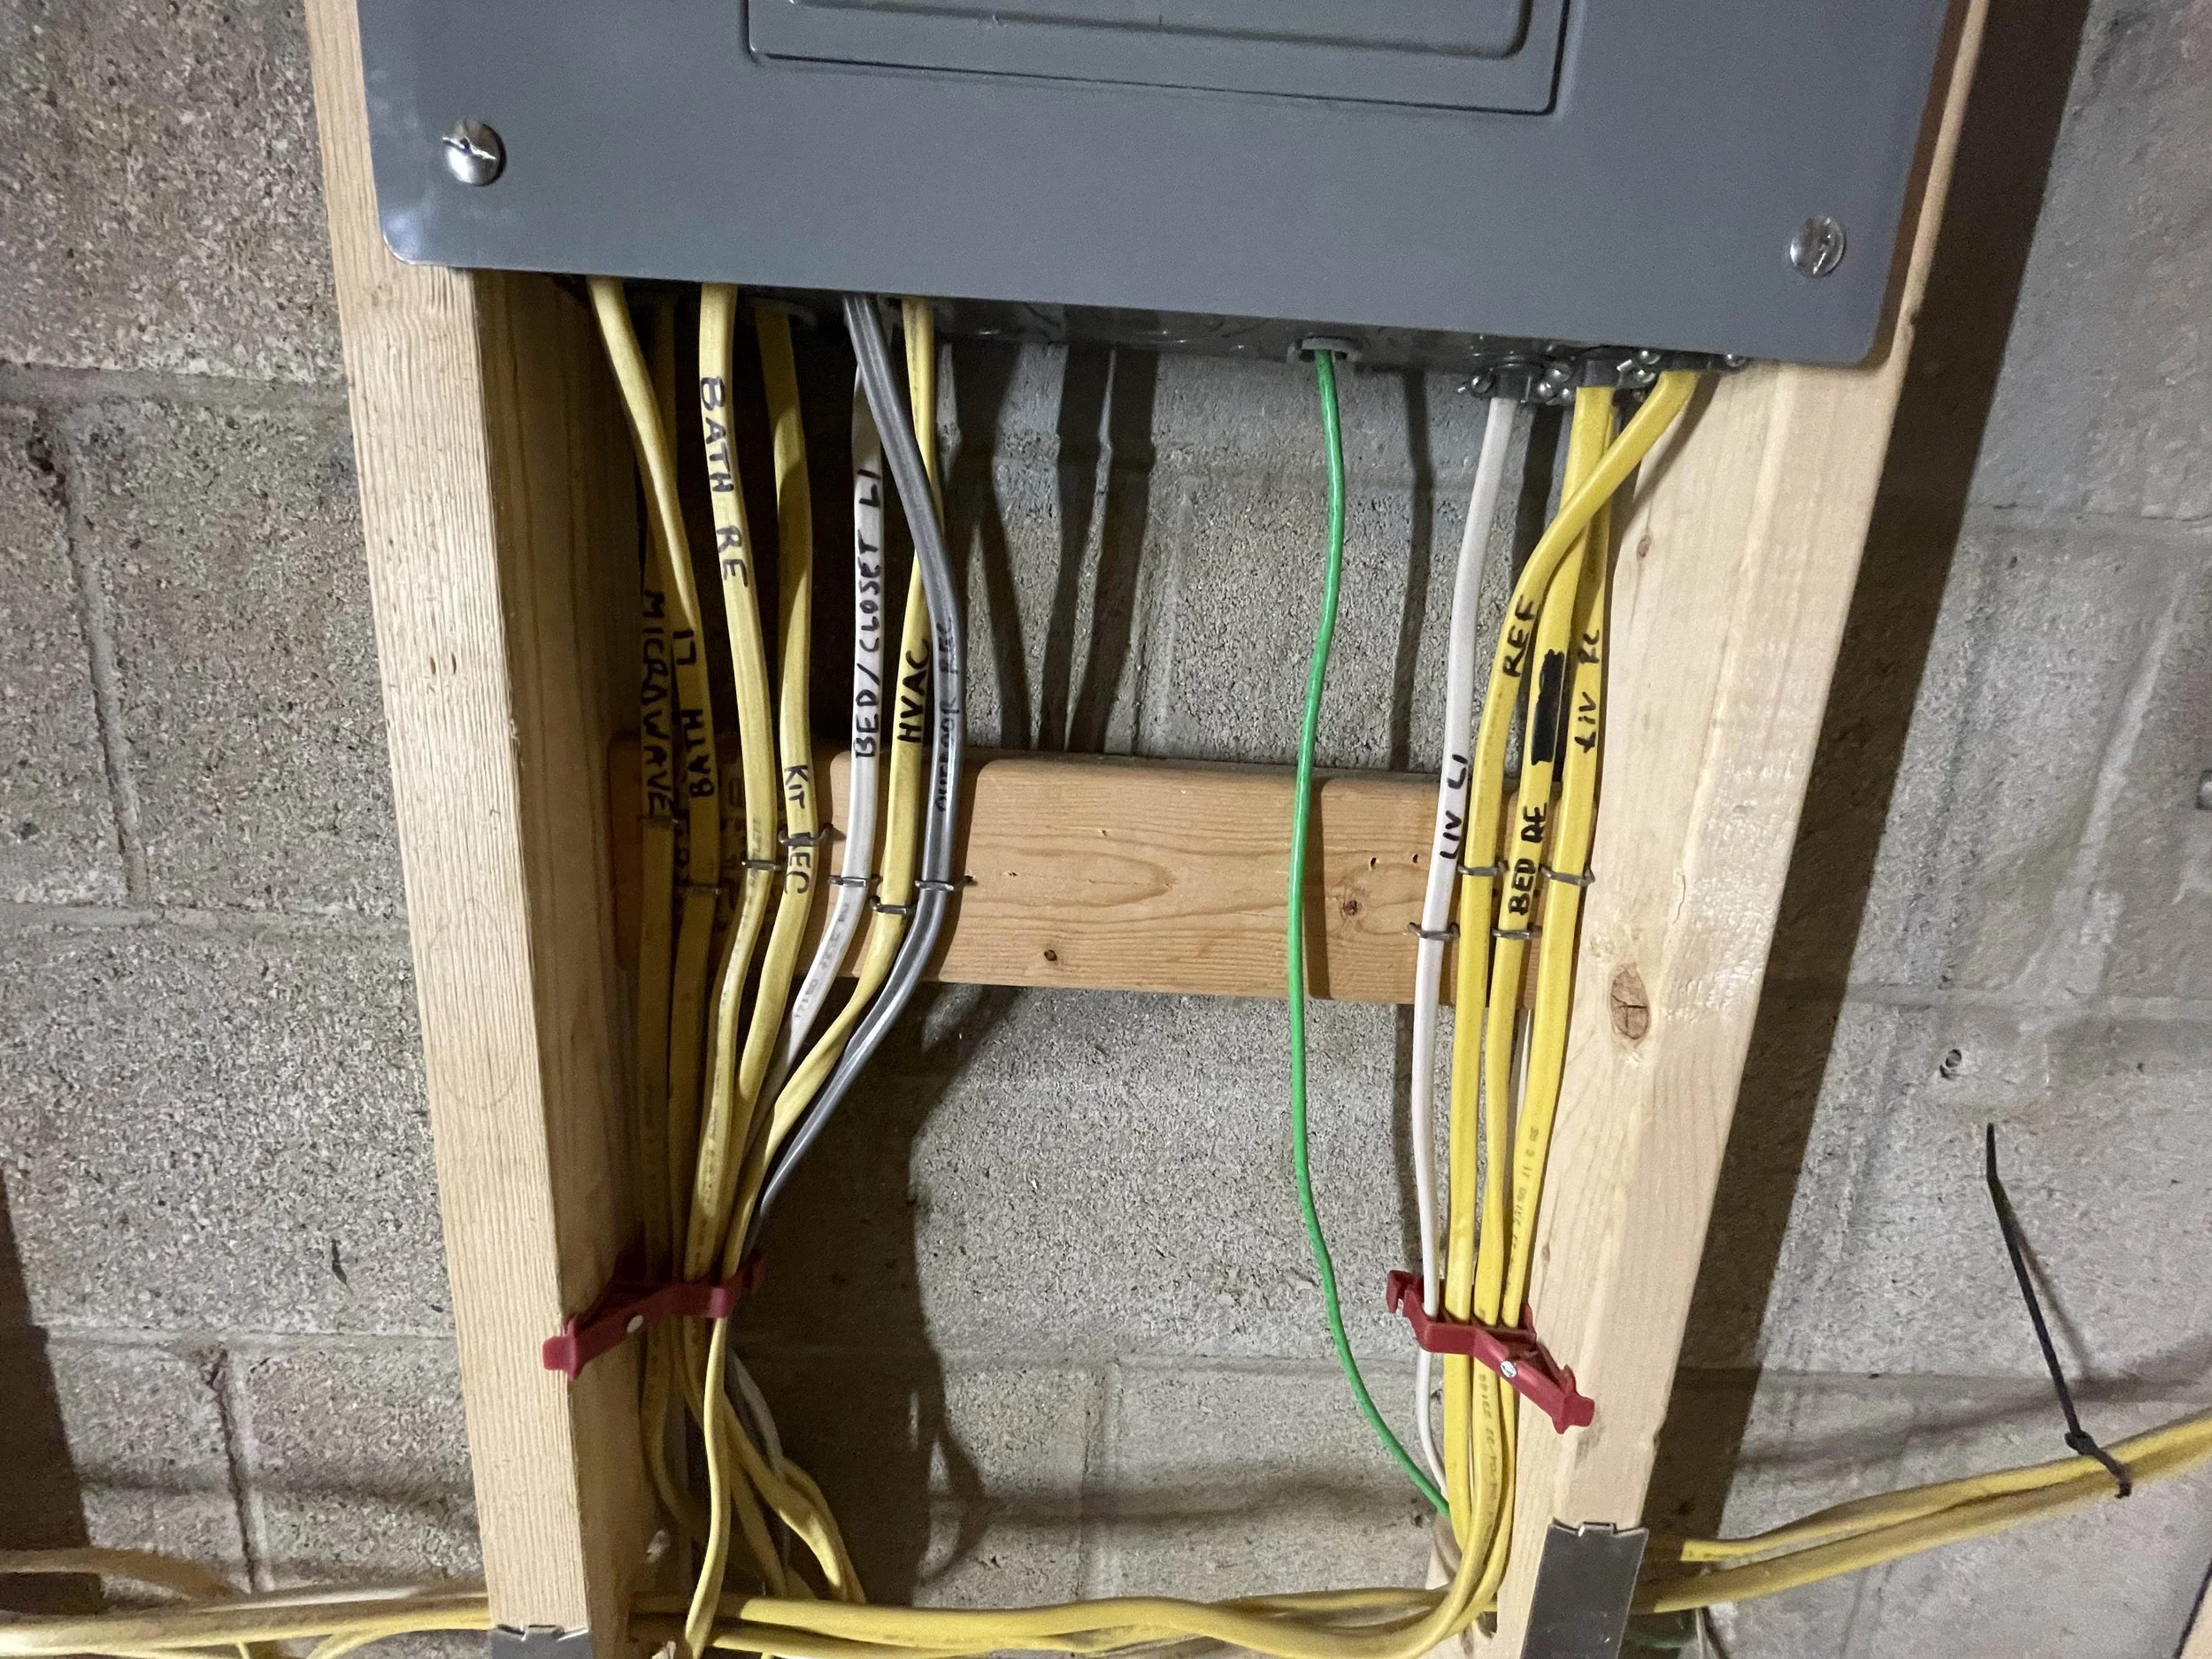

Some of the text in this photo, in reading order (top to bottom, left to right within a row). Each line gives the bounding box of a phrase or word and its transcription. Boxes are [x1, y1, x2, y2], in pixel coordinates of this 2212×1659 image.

[701, 376, 748, 588] BATH RE
[1502, 594, 1538, 678] REF
[896, 638, 932, 743] HVAC
[680, 710, 716, 798] BATH
[784, 764, 810, 810] KIT
[1439, 810, 1463, 860] LIV
[1508, 858, 1538, 917] BED
